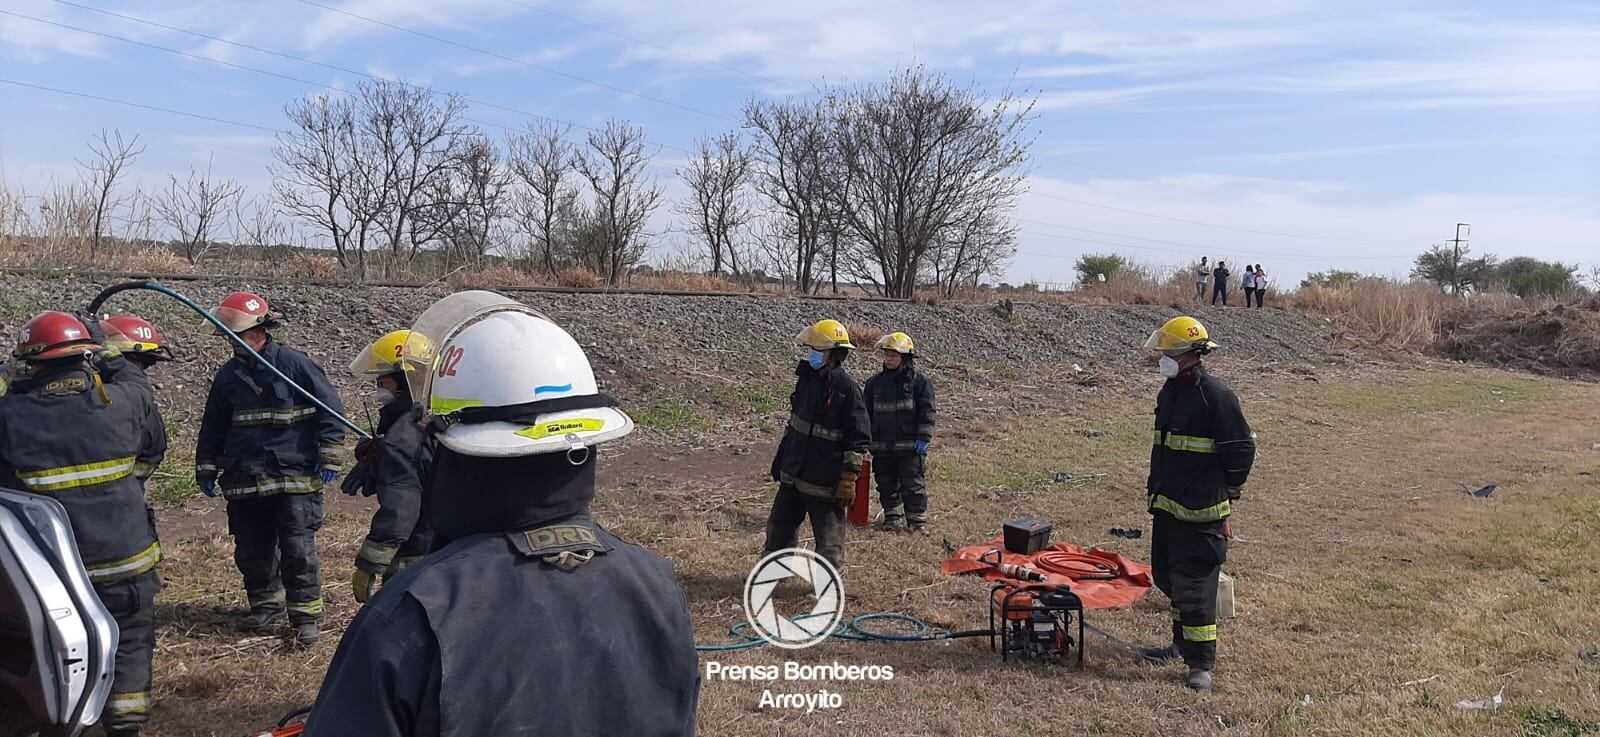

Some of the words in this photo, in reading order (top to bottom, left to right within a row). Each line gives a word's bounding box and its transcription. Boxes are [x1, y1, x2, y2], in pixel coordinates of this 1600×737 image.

[137, 326, 152, 339] 10
[1187, 326, 1200, 337] 33
[438, 345, 465, 378] 02
